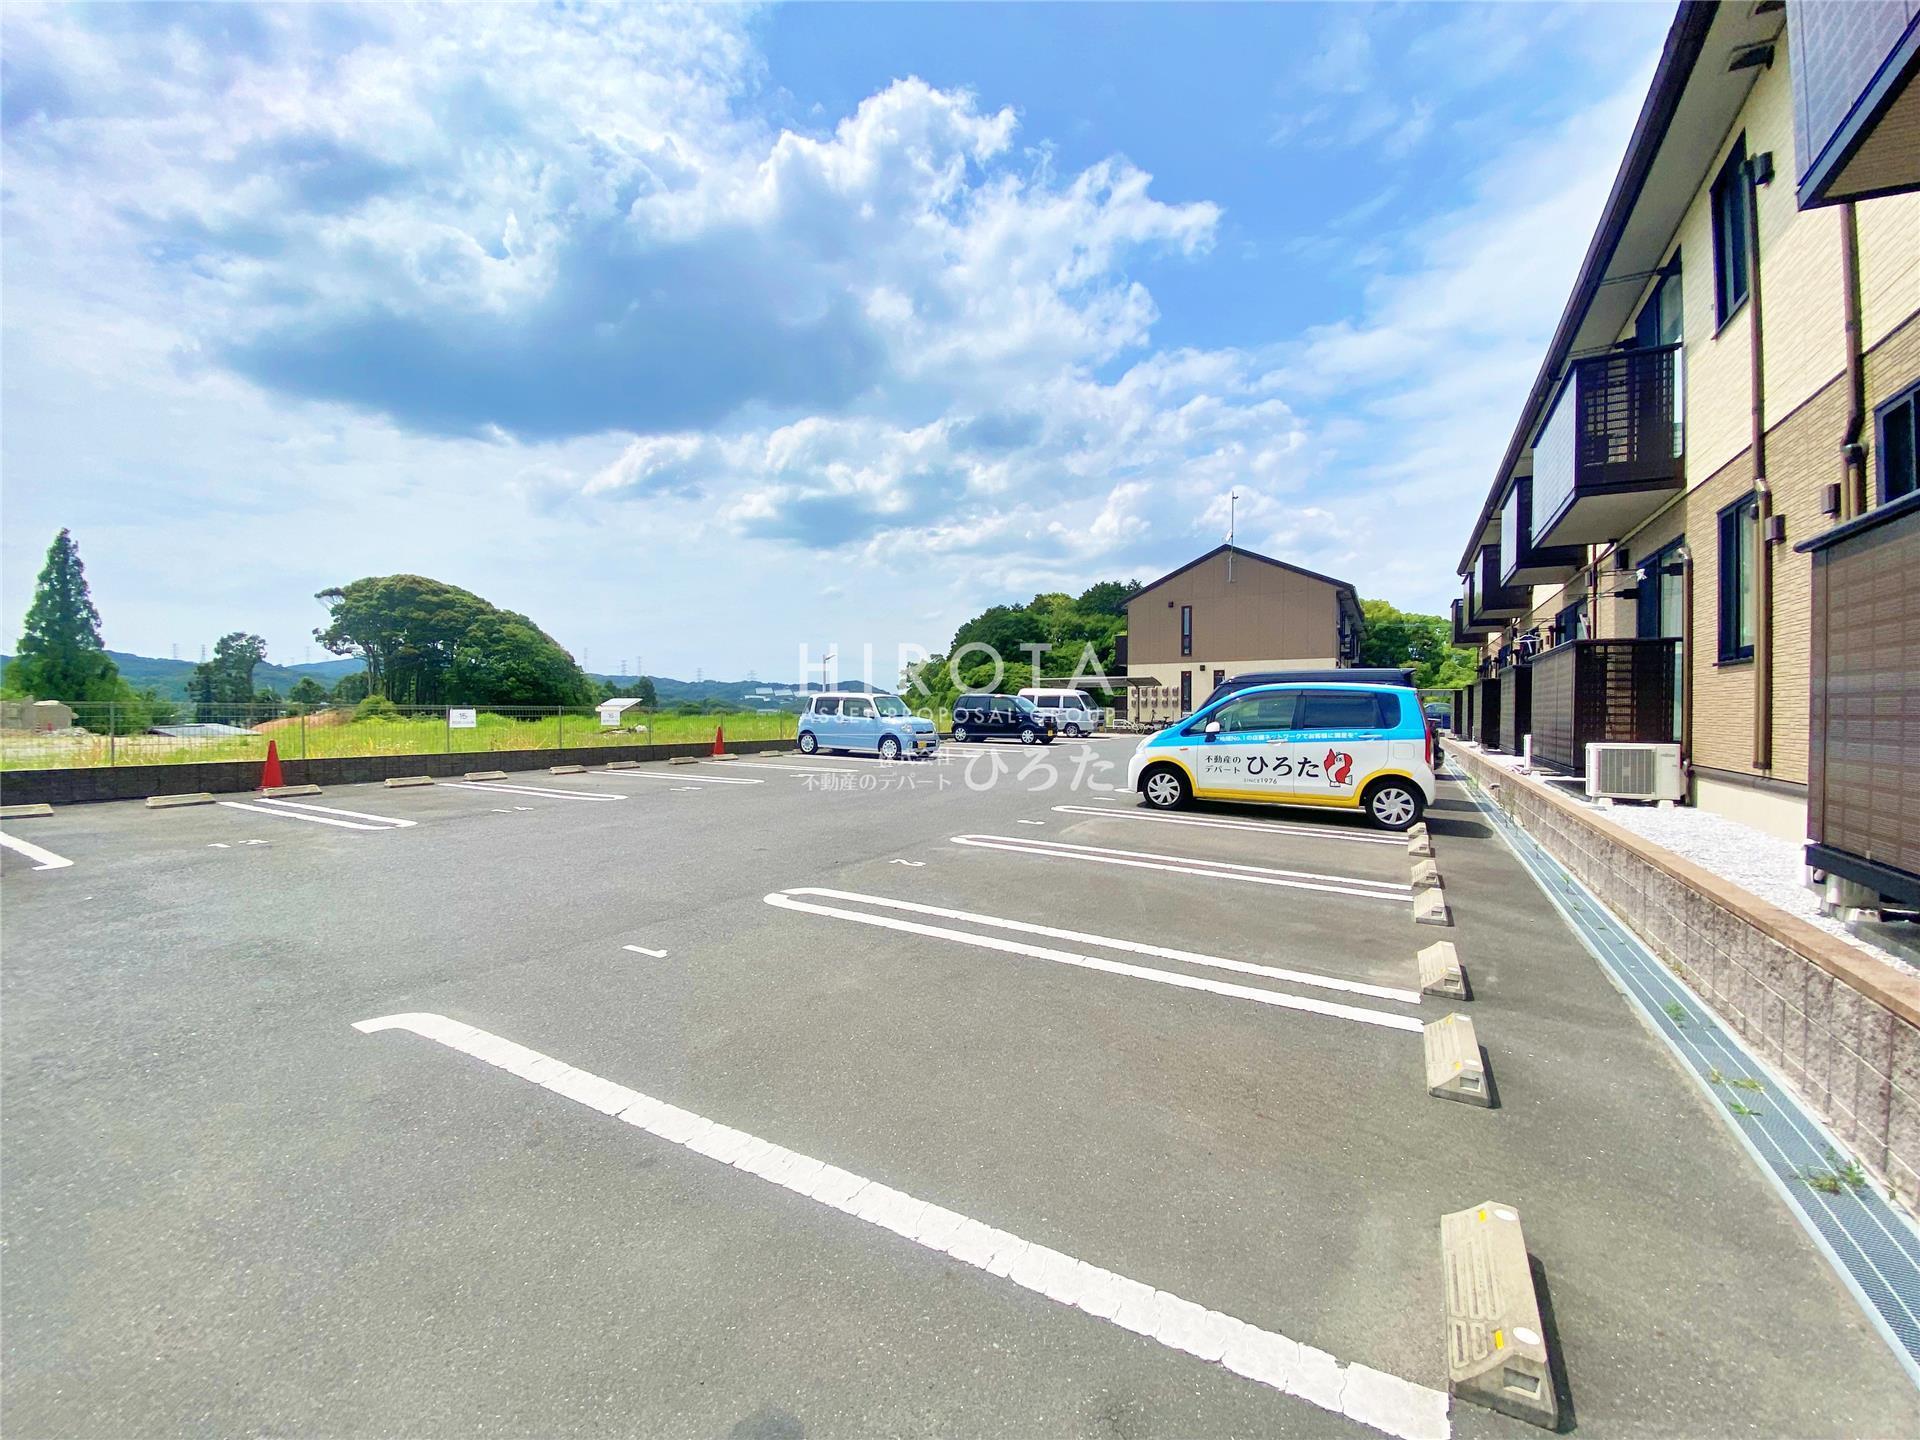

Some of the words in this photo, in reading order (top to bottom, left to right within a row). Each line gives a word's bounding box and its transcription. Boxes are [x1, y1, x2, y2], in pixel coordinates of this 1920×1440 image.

[1205, 754, 1242, 765] 不動産の
[1205, 765, 1241, 776] デパート
[1246, 755, 1320, 778] ひろた
